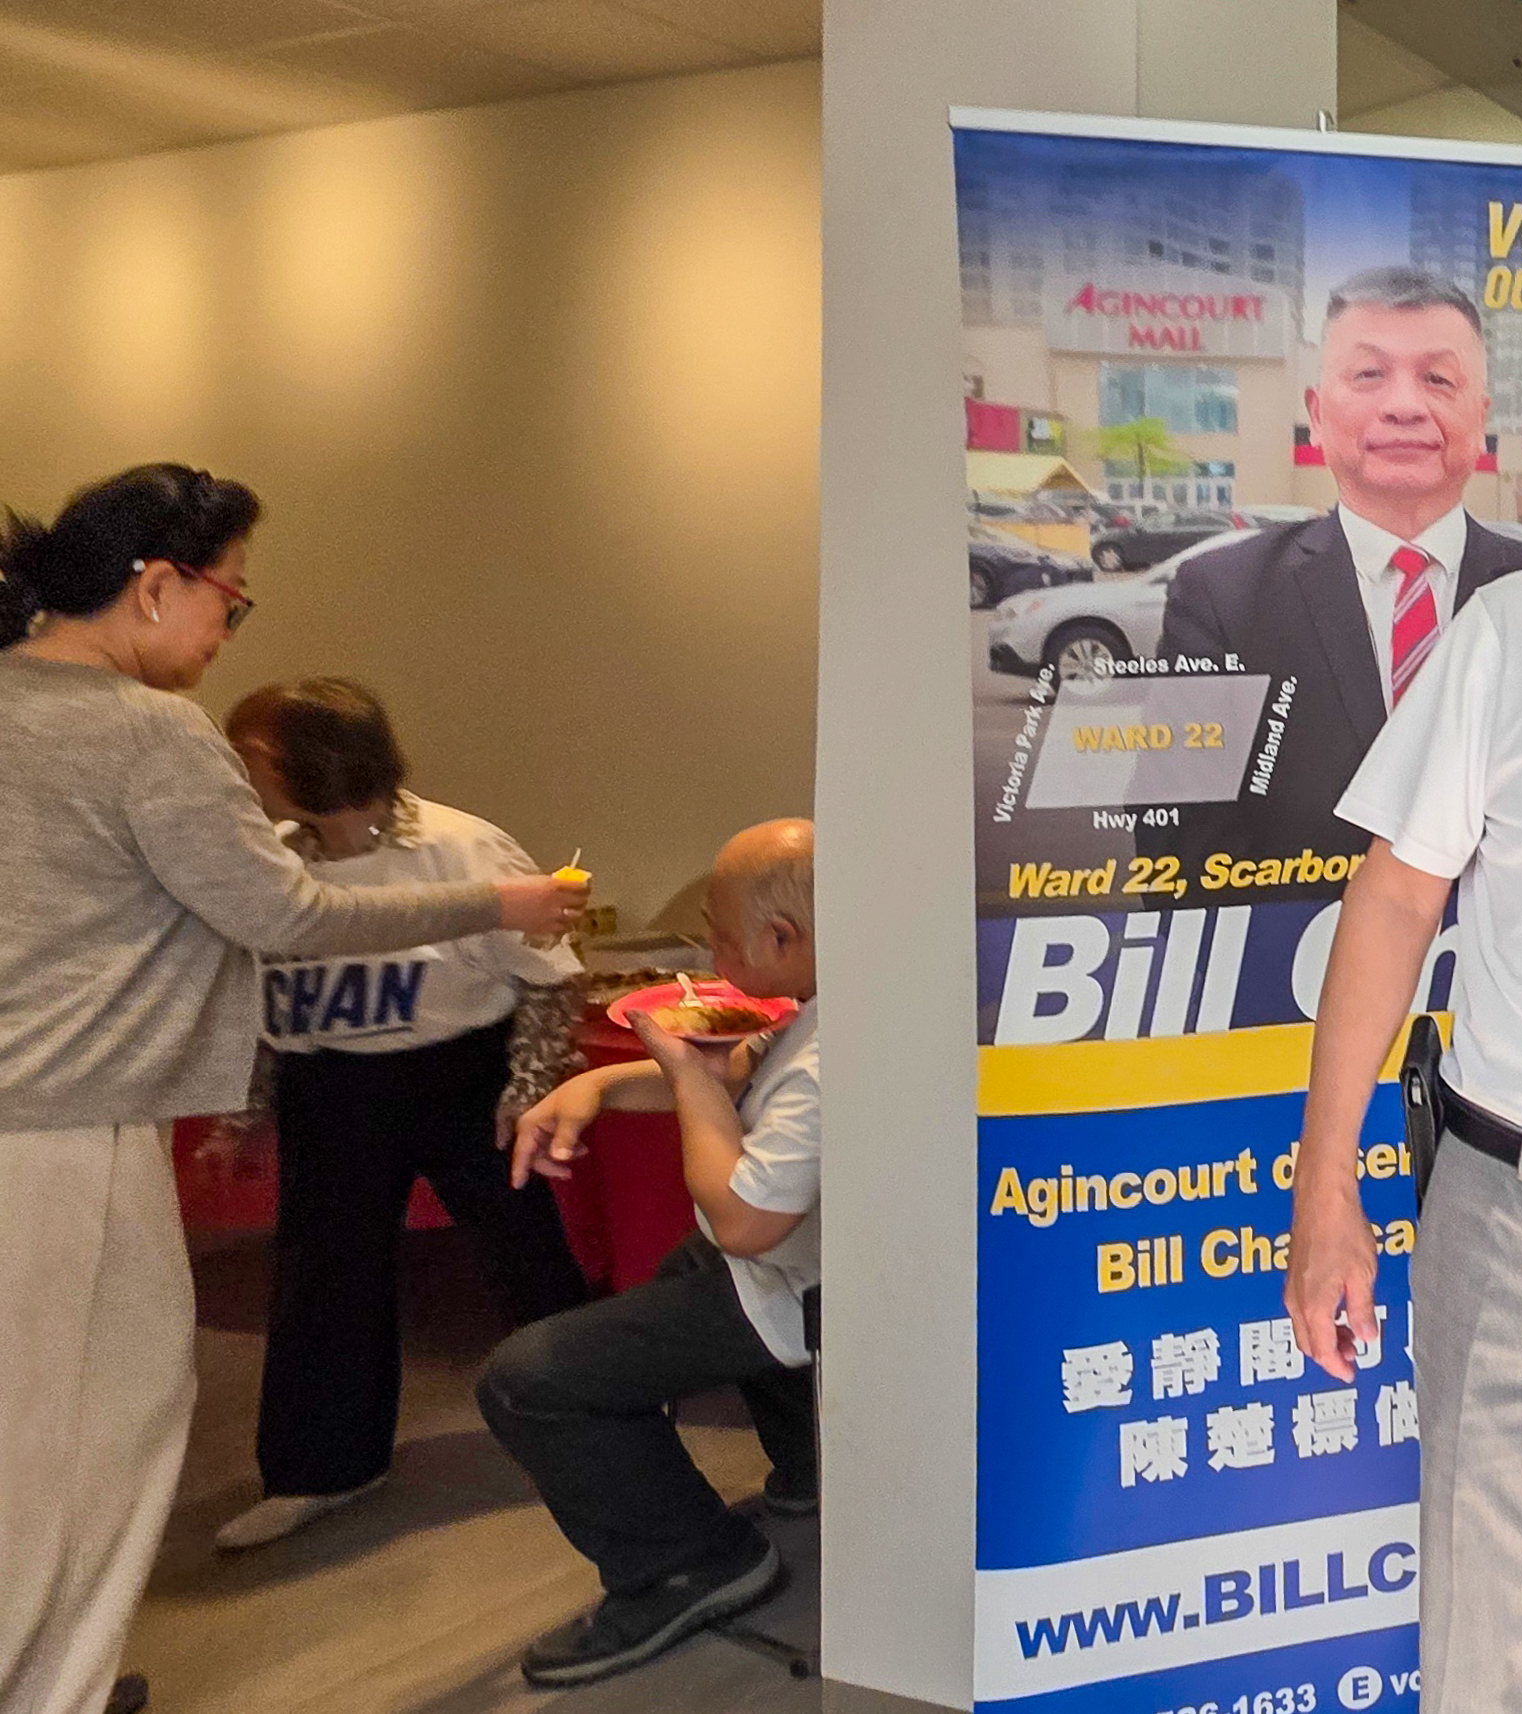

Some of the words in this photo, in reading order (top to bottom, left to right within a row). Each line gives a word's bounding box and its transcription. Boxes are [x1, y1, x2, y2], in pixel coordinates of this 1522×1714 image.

[1064, 282, 1265, 321] AGINCOURT
[1128, 325, 1203, 350] MALL
[1093, 655, 1169, 675] Steeles
[1174, 653, 1219, 673] Ave.
[1224, 653, 1246, 672] E.
[1072, 724, 1173, 753] WARD
[1183, 722, 1224, 749] 22
[1249, 719, 1285, 796] Midland
[1272, 676, 1298, 719] Ave.
[993, 753, 1029, 824] Victoria
[1015, 702, 1043, 751] Park
[1093, 811, 1138, 833] Hwy
[1143, 808, 1180, 828] 401
[1008, 859, 1117, 899] Ward
[1122, 856, 1188, 900] 22,
[264, 961, 428, 1037] CHAN
[994, 905, 1252, 1047] Bill
[990, 1147, 1257, 1228] Agincourt
[1097, 1234, 1184, 1294] Bill
